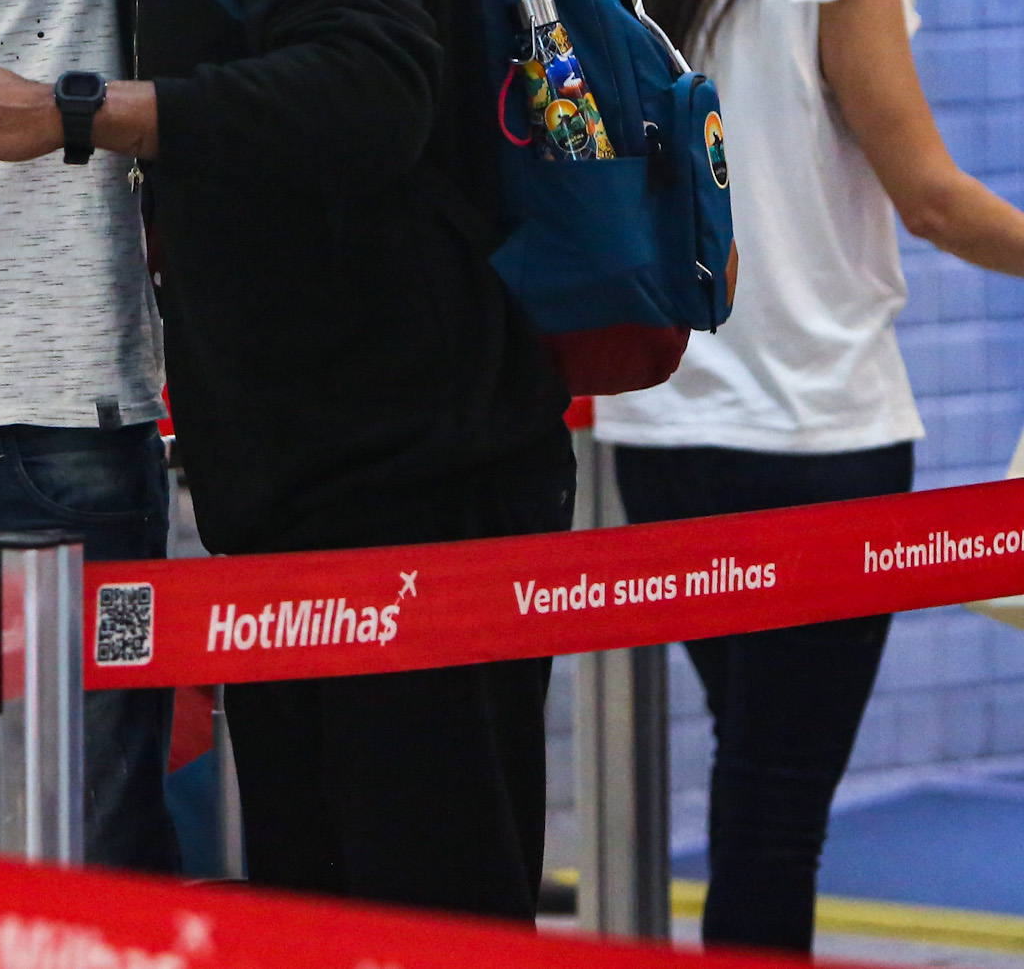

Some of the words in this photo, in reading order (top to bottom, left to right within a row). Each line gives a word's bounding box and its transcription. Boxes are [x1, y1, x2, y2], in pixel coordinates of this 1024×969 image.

[513, 573, 606, 615] Venda
[613, 574, 678, 606] suas
[685, 556, 776, 597] milhas
